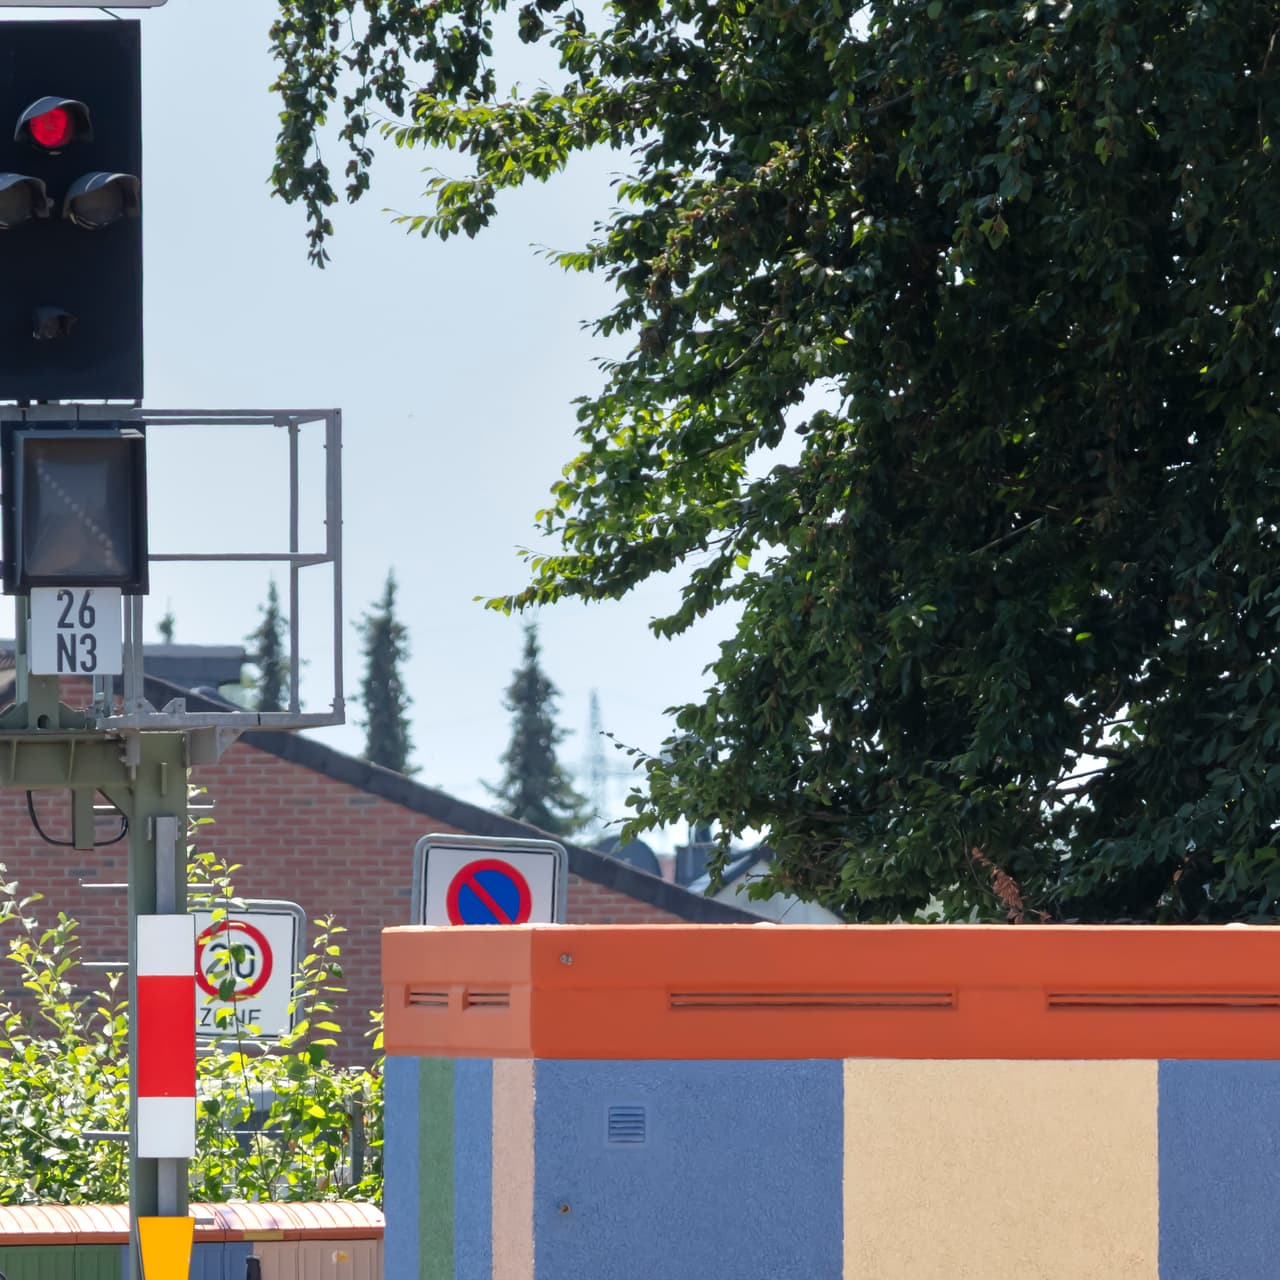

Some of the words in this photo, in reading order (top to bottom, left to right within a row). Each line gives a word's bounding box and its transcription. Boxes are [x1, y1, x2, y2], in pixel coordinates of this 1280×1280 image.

[57, 589, 96, 629] 26
[57, 633, 97, 673] N3
[200, 1007, 262, 1027] ZNE
